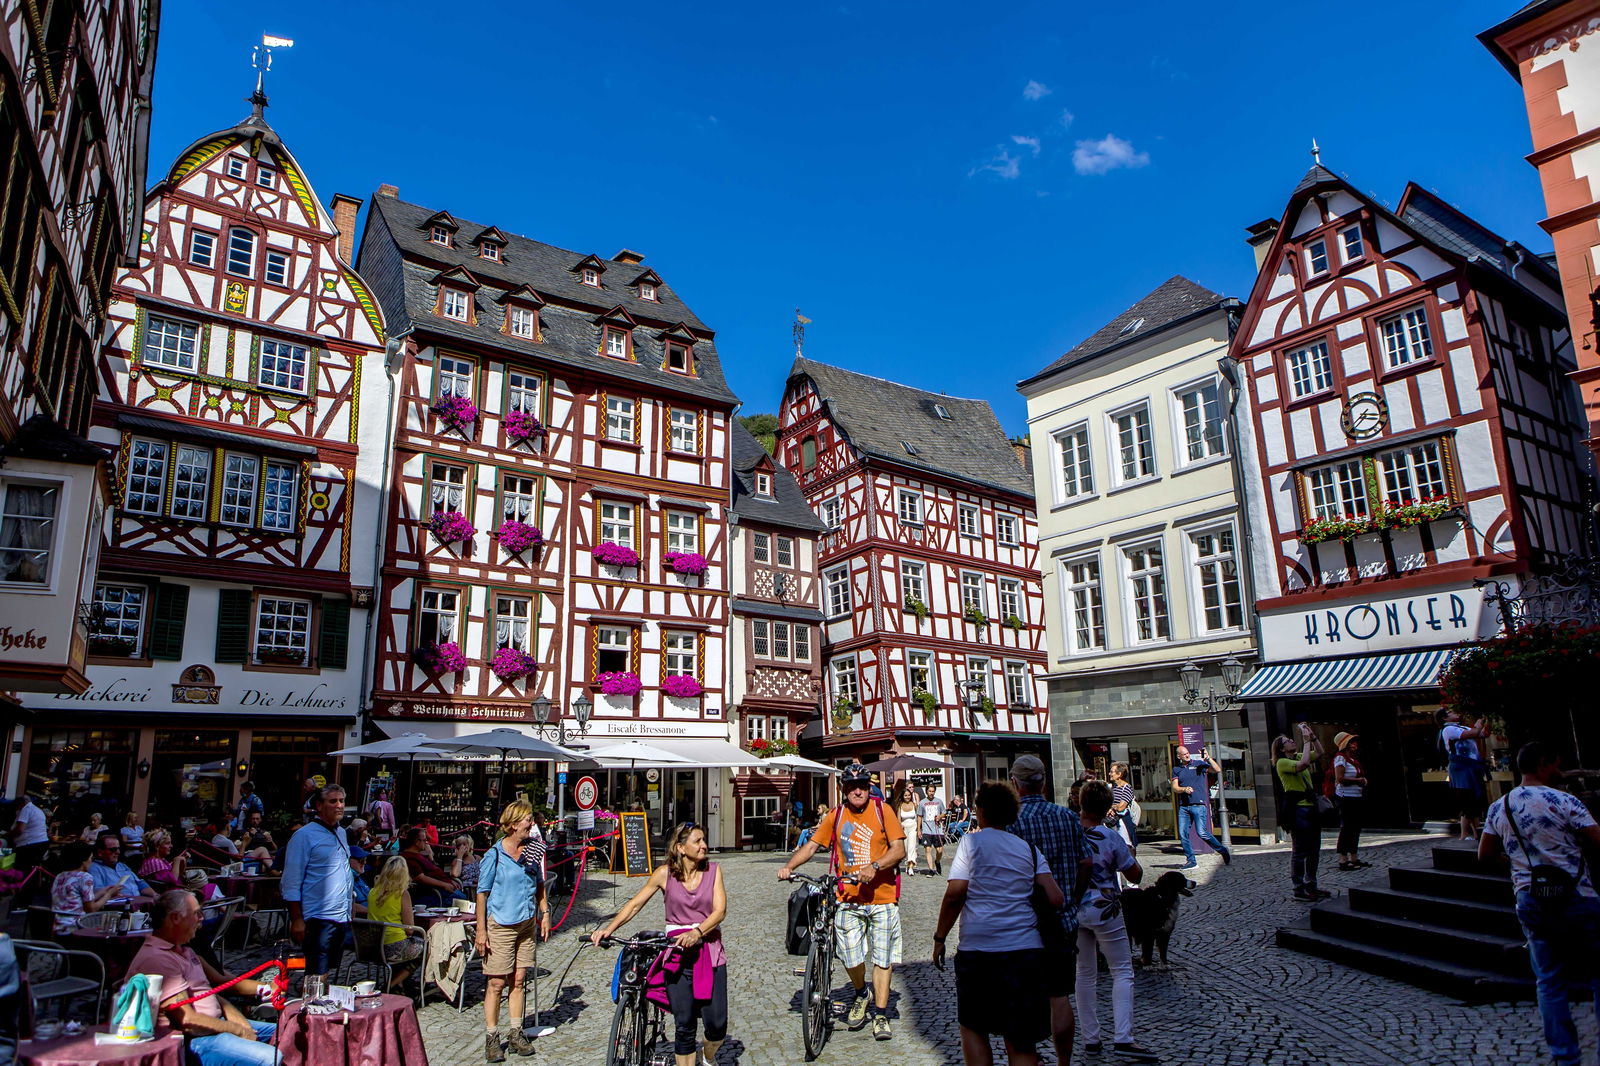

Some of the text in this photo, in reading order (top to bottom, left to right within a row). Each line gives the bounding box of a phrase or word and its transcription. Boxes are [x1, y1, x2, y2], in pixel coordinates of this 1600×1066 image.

[1305, 594, 1467, 645] KRONSER
[240, 689, 274, 706] Die
[413, 704, 525, 718] Weinhaus Schnitzius
[607, 723, 686, 735] Eiscafé Bressanone
